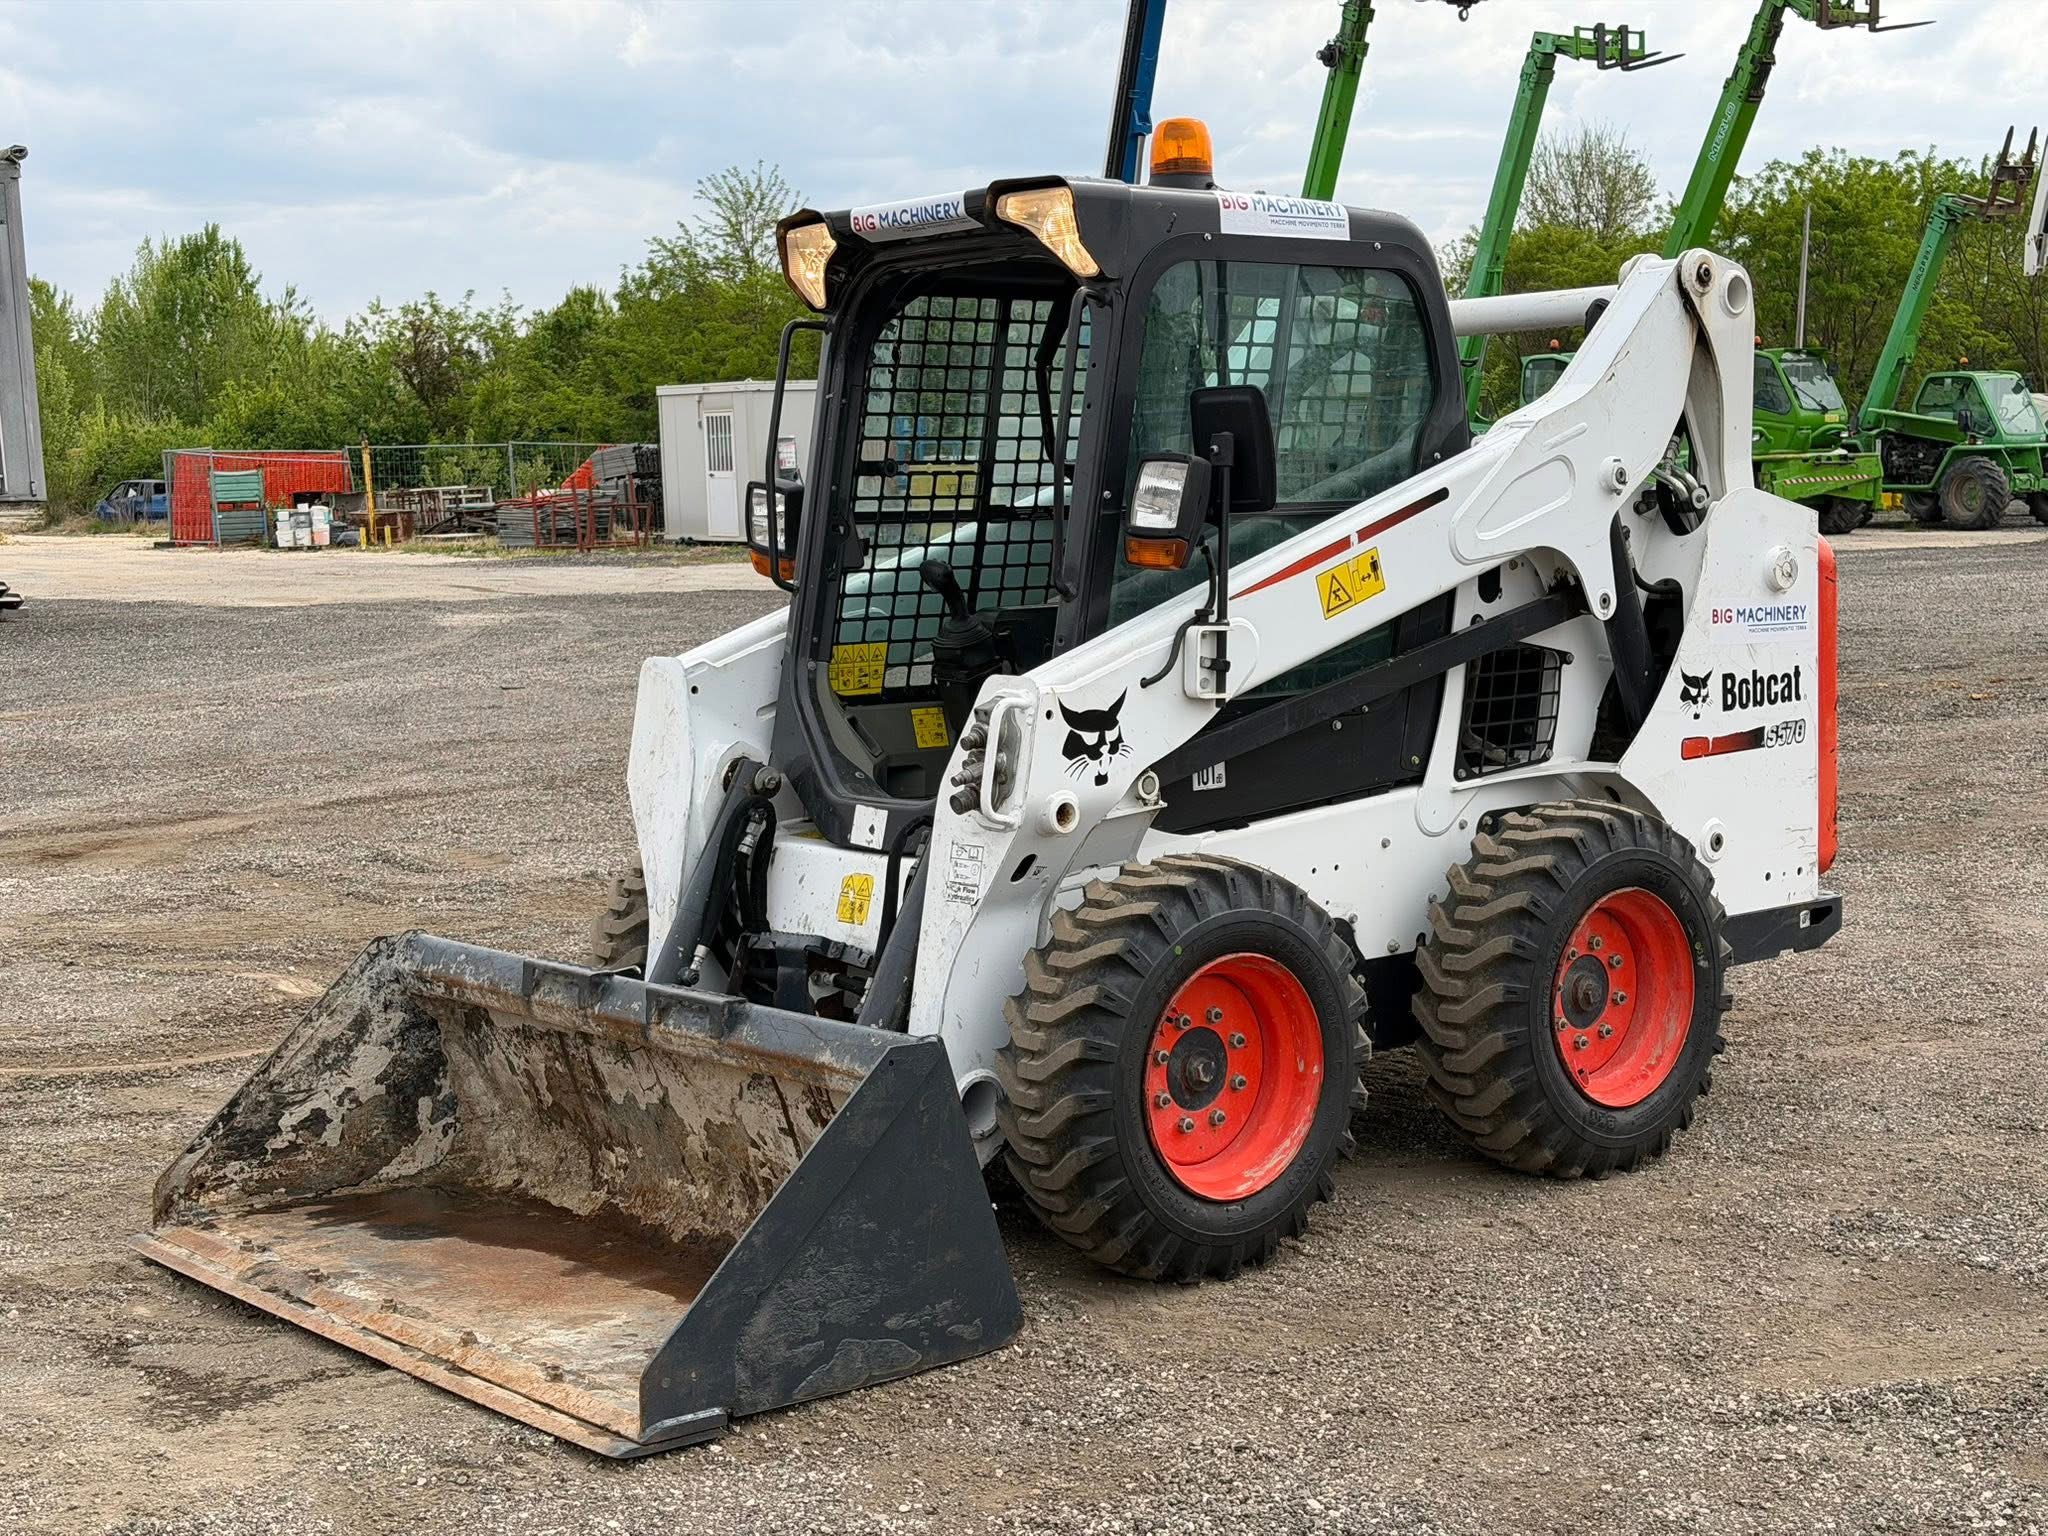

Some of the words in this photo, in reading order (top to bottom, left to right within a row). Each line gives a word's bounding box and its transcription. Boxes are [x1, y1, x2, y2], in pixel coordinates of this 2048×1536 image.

[853, 214, 877, 232] BIG
[879, 201, 960, 229] MACHINERY
[1221, 196, 1249, 211] BIG
[1251, 197, 1342, 217] MACHINERY
[1712, 608, 1733, 624] BIG
[1736, 605, 1807, 623] MACHINERY
[1721, 665, 1802, 712] Bobcat
[1766, 718, 1806, 748] S570
[1197, 765, 1215, 786] 101
[947, 894, 975, 902] ydraulics
